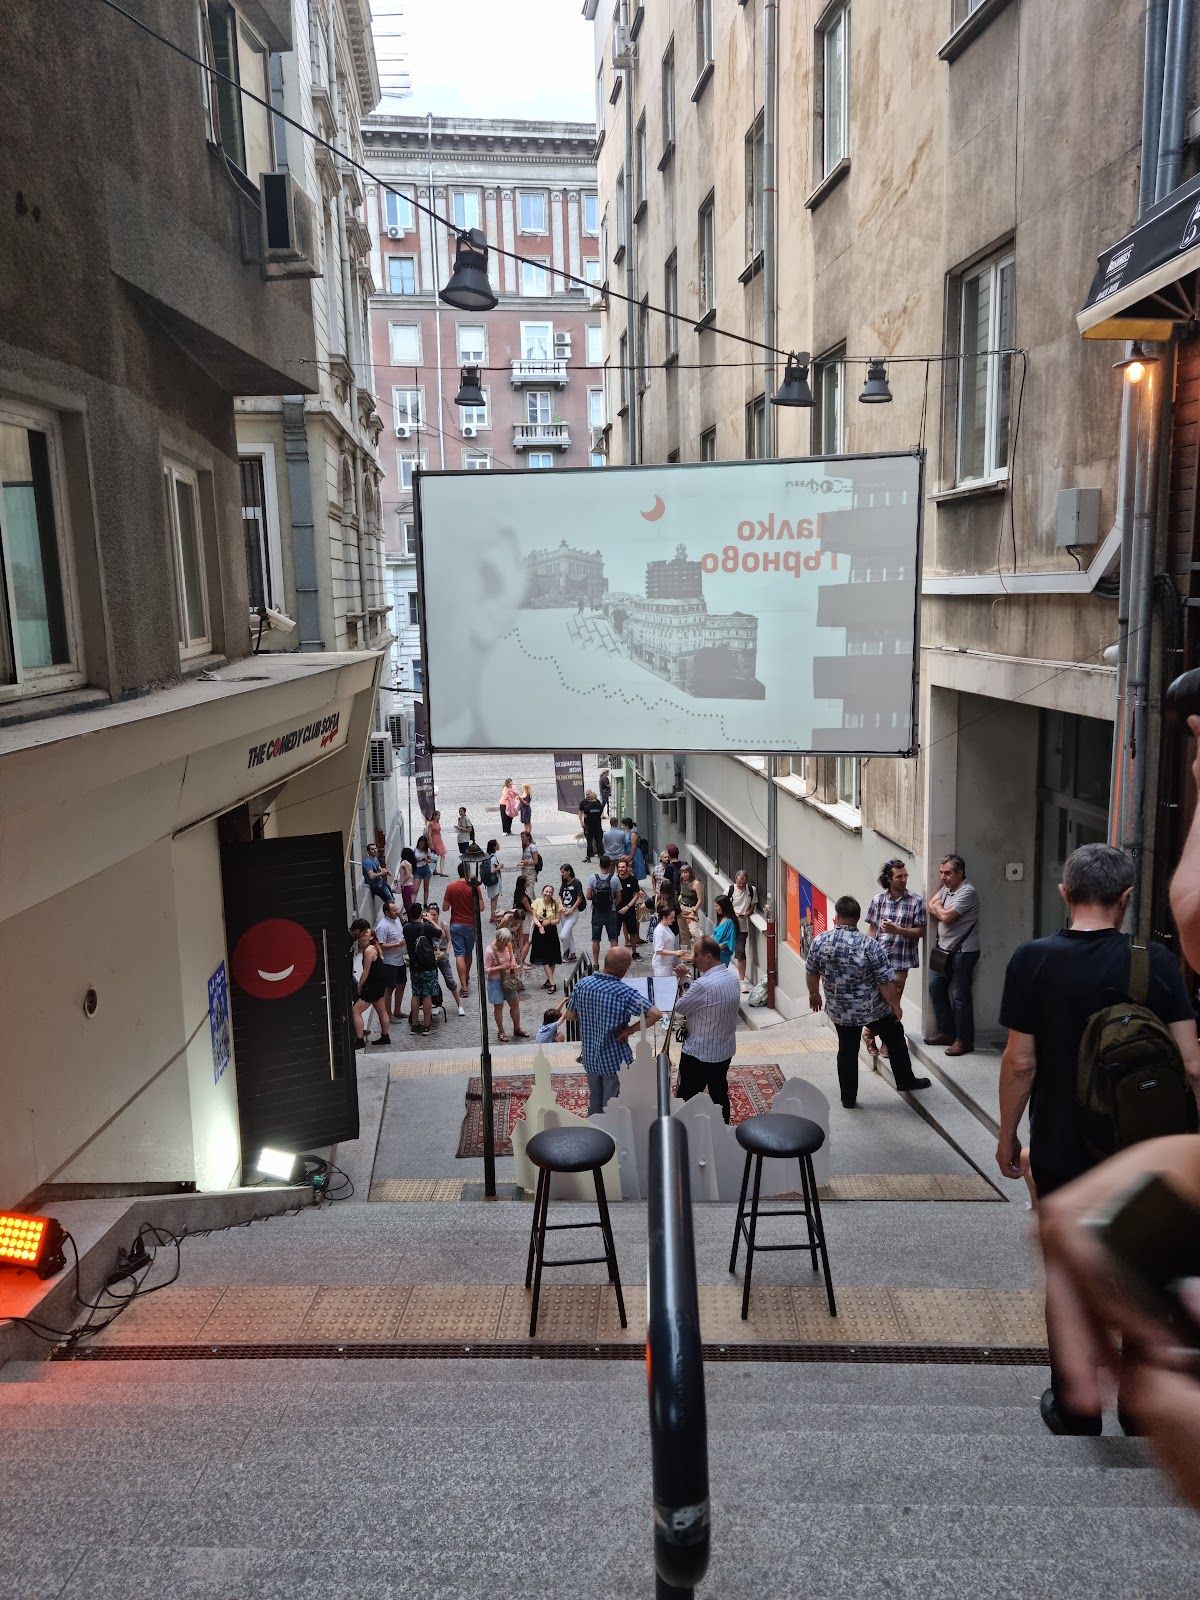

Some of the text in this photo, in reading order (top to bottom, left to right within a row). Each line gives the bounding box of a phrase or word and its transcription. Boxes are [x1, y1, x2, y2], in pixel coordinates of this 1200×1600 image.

[247, 742, 268, 769] THE
[266, 728, 304, 761] COMEDY
[302, 720, 322, 744] CLUB
